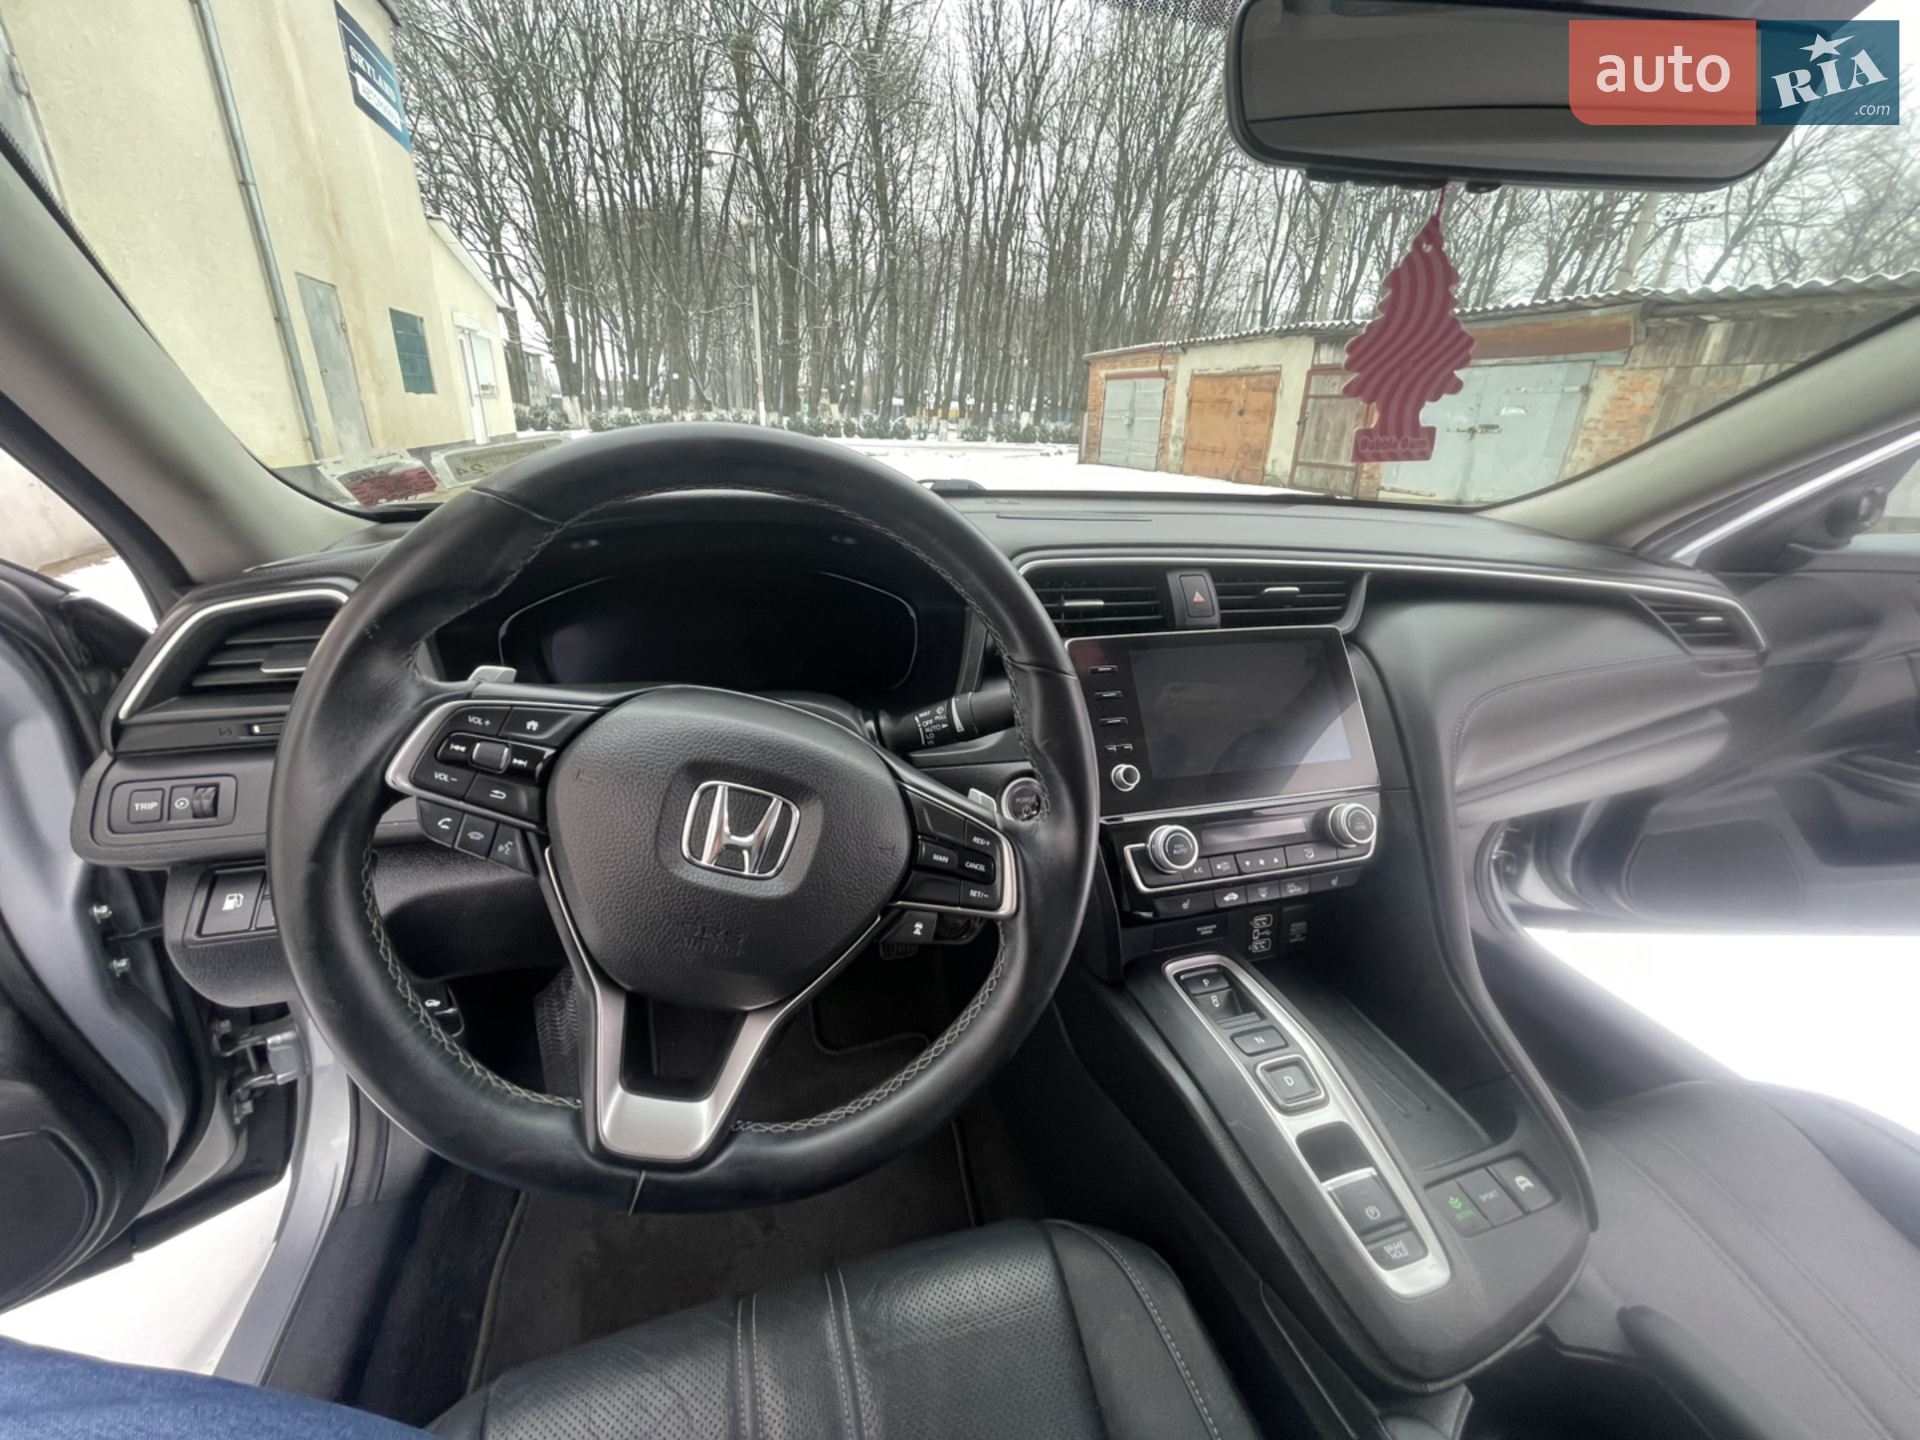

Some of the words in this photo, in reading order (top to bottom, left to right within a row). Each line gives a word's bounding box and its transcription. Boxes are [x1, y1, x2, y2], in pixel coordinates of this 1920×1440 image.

[1360, 435, 1399, 451] Bubble
[134, 801, 158, 812] TRIP
[932, 853, 949, 864] MAIN
[964, 861, 986, 873] CANCEL
[1202, 979, 1210, 987] P
[1254, 1036, 1265, 1045] N
[1283, 1076, 1295, 1087] D
[1478, 1189, 1500, 1203] SPORT
[1383, 1239, 1405, 1254] BRAKE
[1390, 1247, 1409, 1261] HOLD
